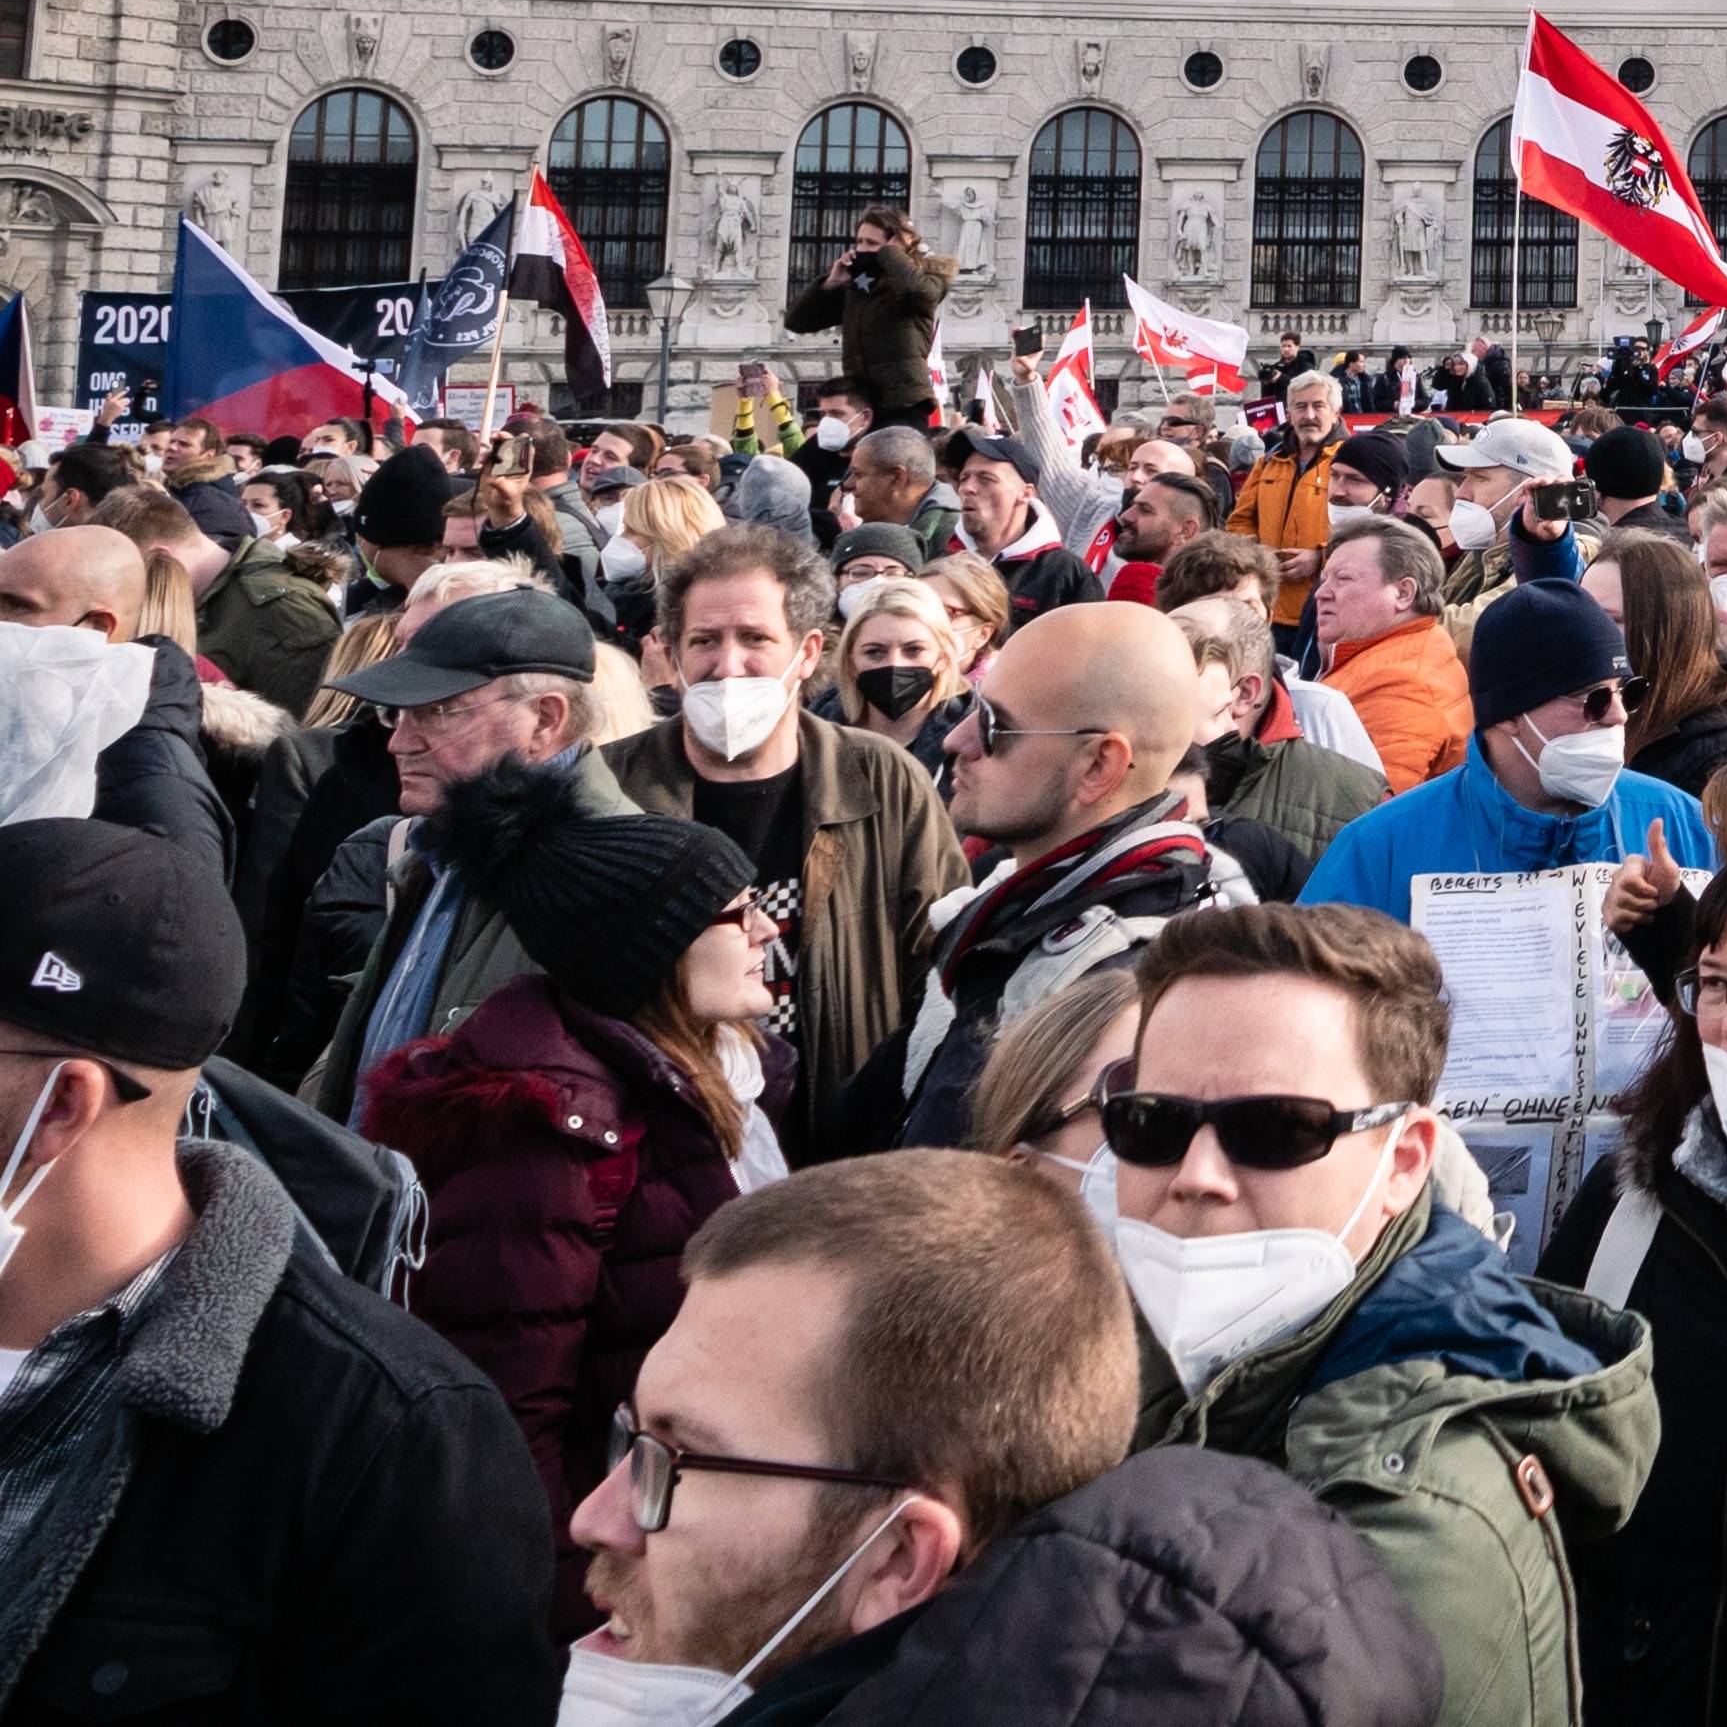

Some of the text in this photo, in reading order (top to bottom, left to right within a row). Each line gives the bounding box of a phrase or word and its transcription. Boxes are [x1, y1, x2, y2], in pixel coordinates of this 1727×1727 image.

[1430, 876, 1503, 891] BEREITS
[1570, 869, 1589, 999] WIEVIELE
[1503, 1094, 1571, 1119] OHNE
